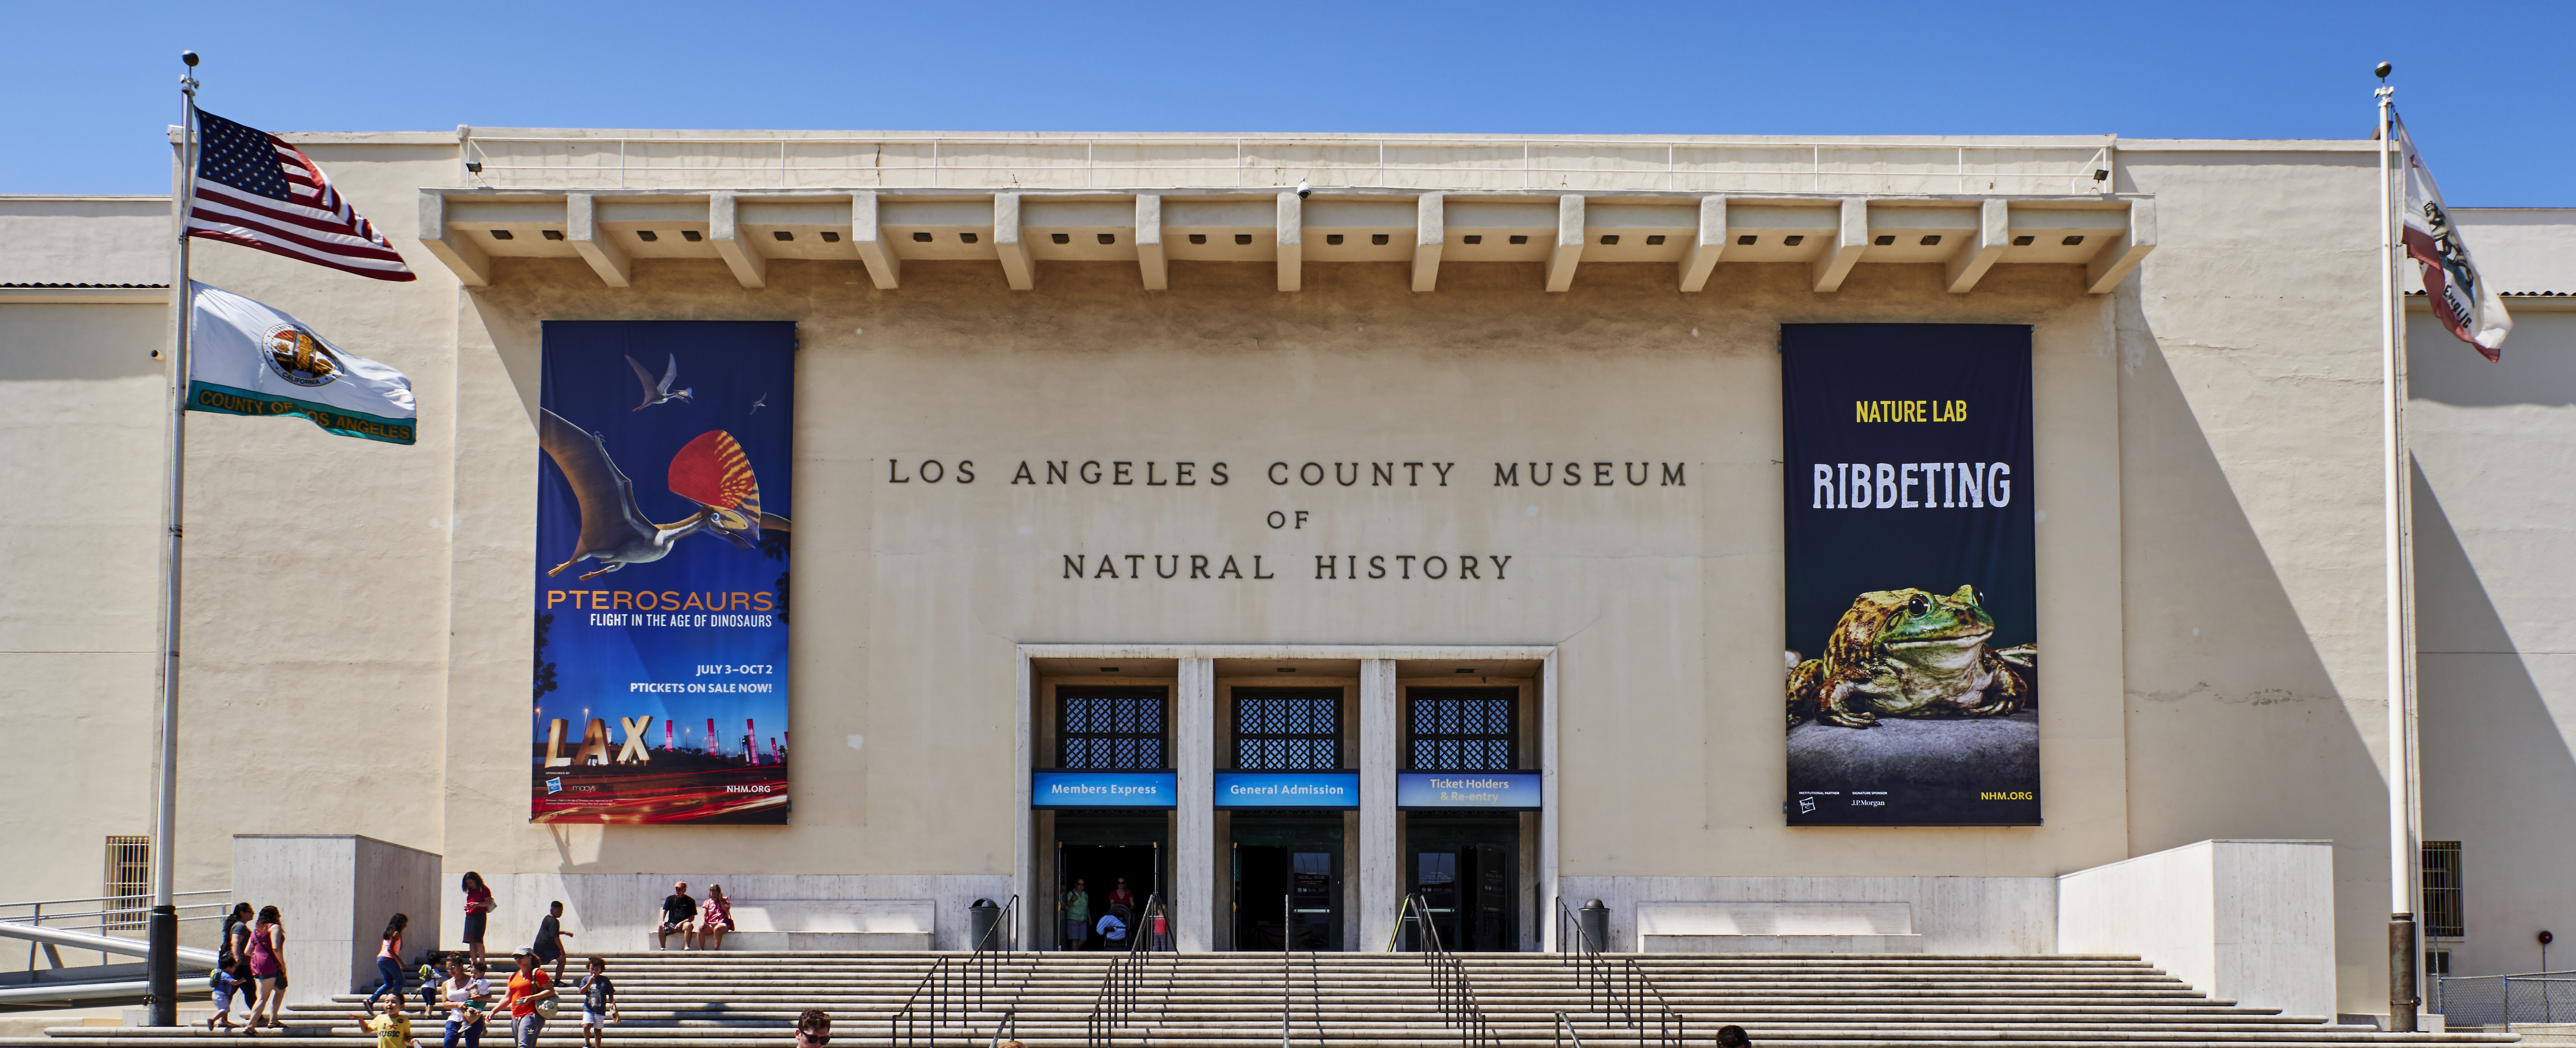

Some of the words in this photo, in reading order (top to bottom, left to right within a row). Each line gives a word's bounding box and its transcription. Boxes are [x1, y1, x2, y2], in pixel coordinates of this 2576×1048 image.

[283, 372, 321, 385] CALIFORNIA
[199, 391, 264, 414] COUNTY
[271, 401, 293, 414] OF
[300, 407, 330, 427] OS
[335, 419, 411, 440] ANGELES
[1856, 400, 1927, 422] NATURE
[1933, 400, 1967, 422] LAB
[889, 460, 975, 484] LOS
[1011, 460, 1229, 486] ANGELES
[1268, 462, 1455, 486] COUNTY
[1494, 462, 1686, 486] MUSEUM
[1813, 462, 2010, 509] RIBBETING
[1267, 511, 1308, 529] OF
[1063, 554, 1274, 579] NATURAL
[1315, 555, 1512, 579] HISTORY
[547, 590, 773, 611] PTEROSAURS
[590, 613, 628, 626] FLIGHT
[632, 614, 642, 626] IN
[646, 614, 666, 627] THE
[670, 614, 691, 627] AGE
[694, 614, 707, 627] OF
[711, 614, 772, 627] DINOSAURS
[696, 665, 723, 677] JULY
[630, 682, 685, 693] PTICKETS
[687, 683, 706, 693] ON
[708, 683, 736, 693] SALE
[738, 683, 772, 693] NOW!
[544, 715, 653, 768] LAX
[726, 785, 771, 793] NHM.ORG
[1052, 784, 1107, 794] Members
[1111, 785, 1156, 796] Express
[1230, 784, 1277, 795] General
[1281, 784, 1344, 795] Admission
[1430, 778, 1463, 788] Ticket
[1466, 779, 1509, 789] Holders
[1440, 791, 1448, 801] &
[1451, 792, 1499, 804] Re-entry
[1981, 792, 2033, 800] NHM.ORG
